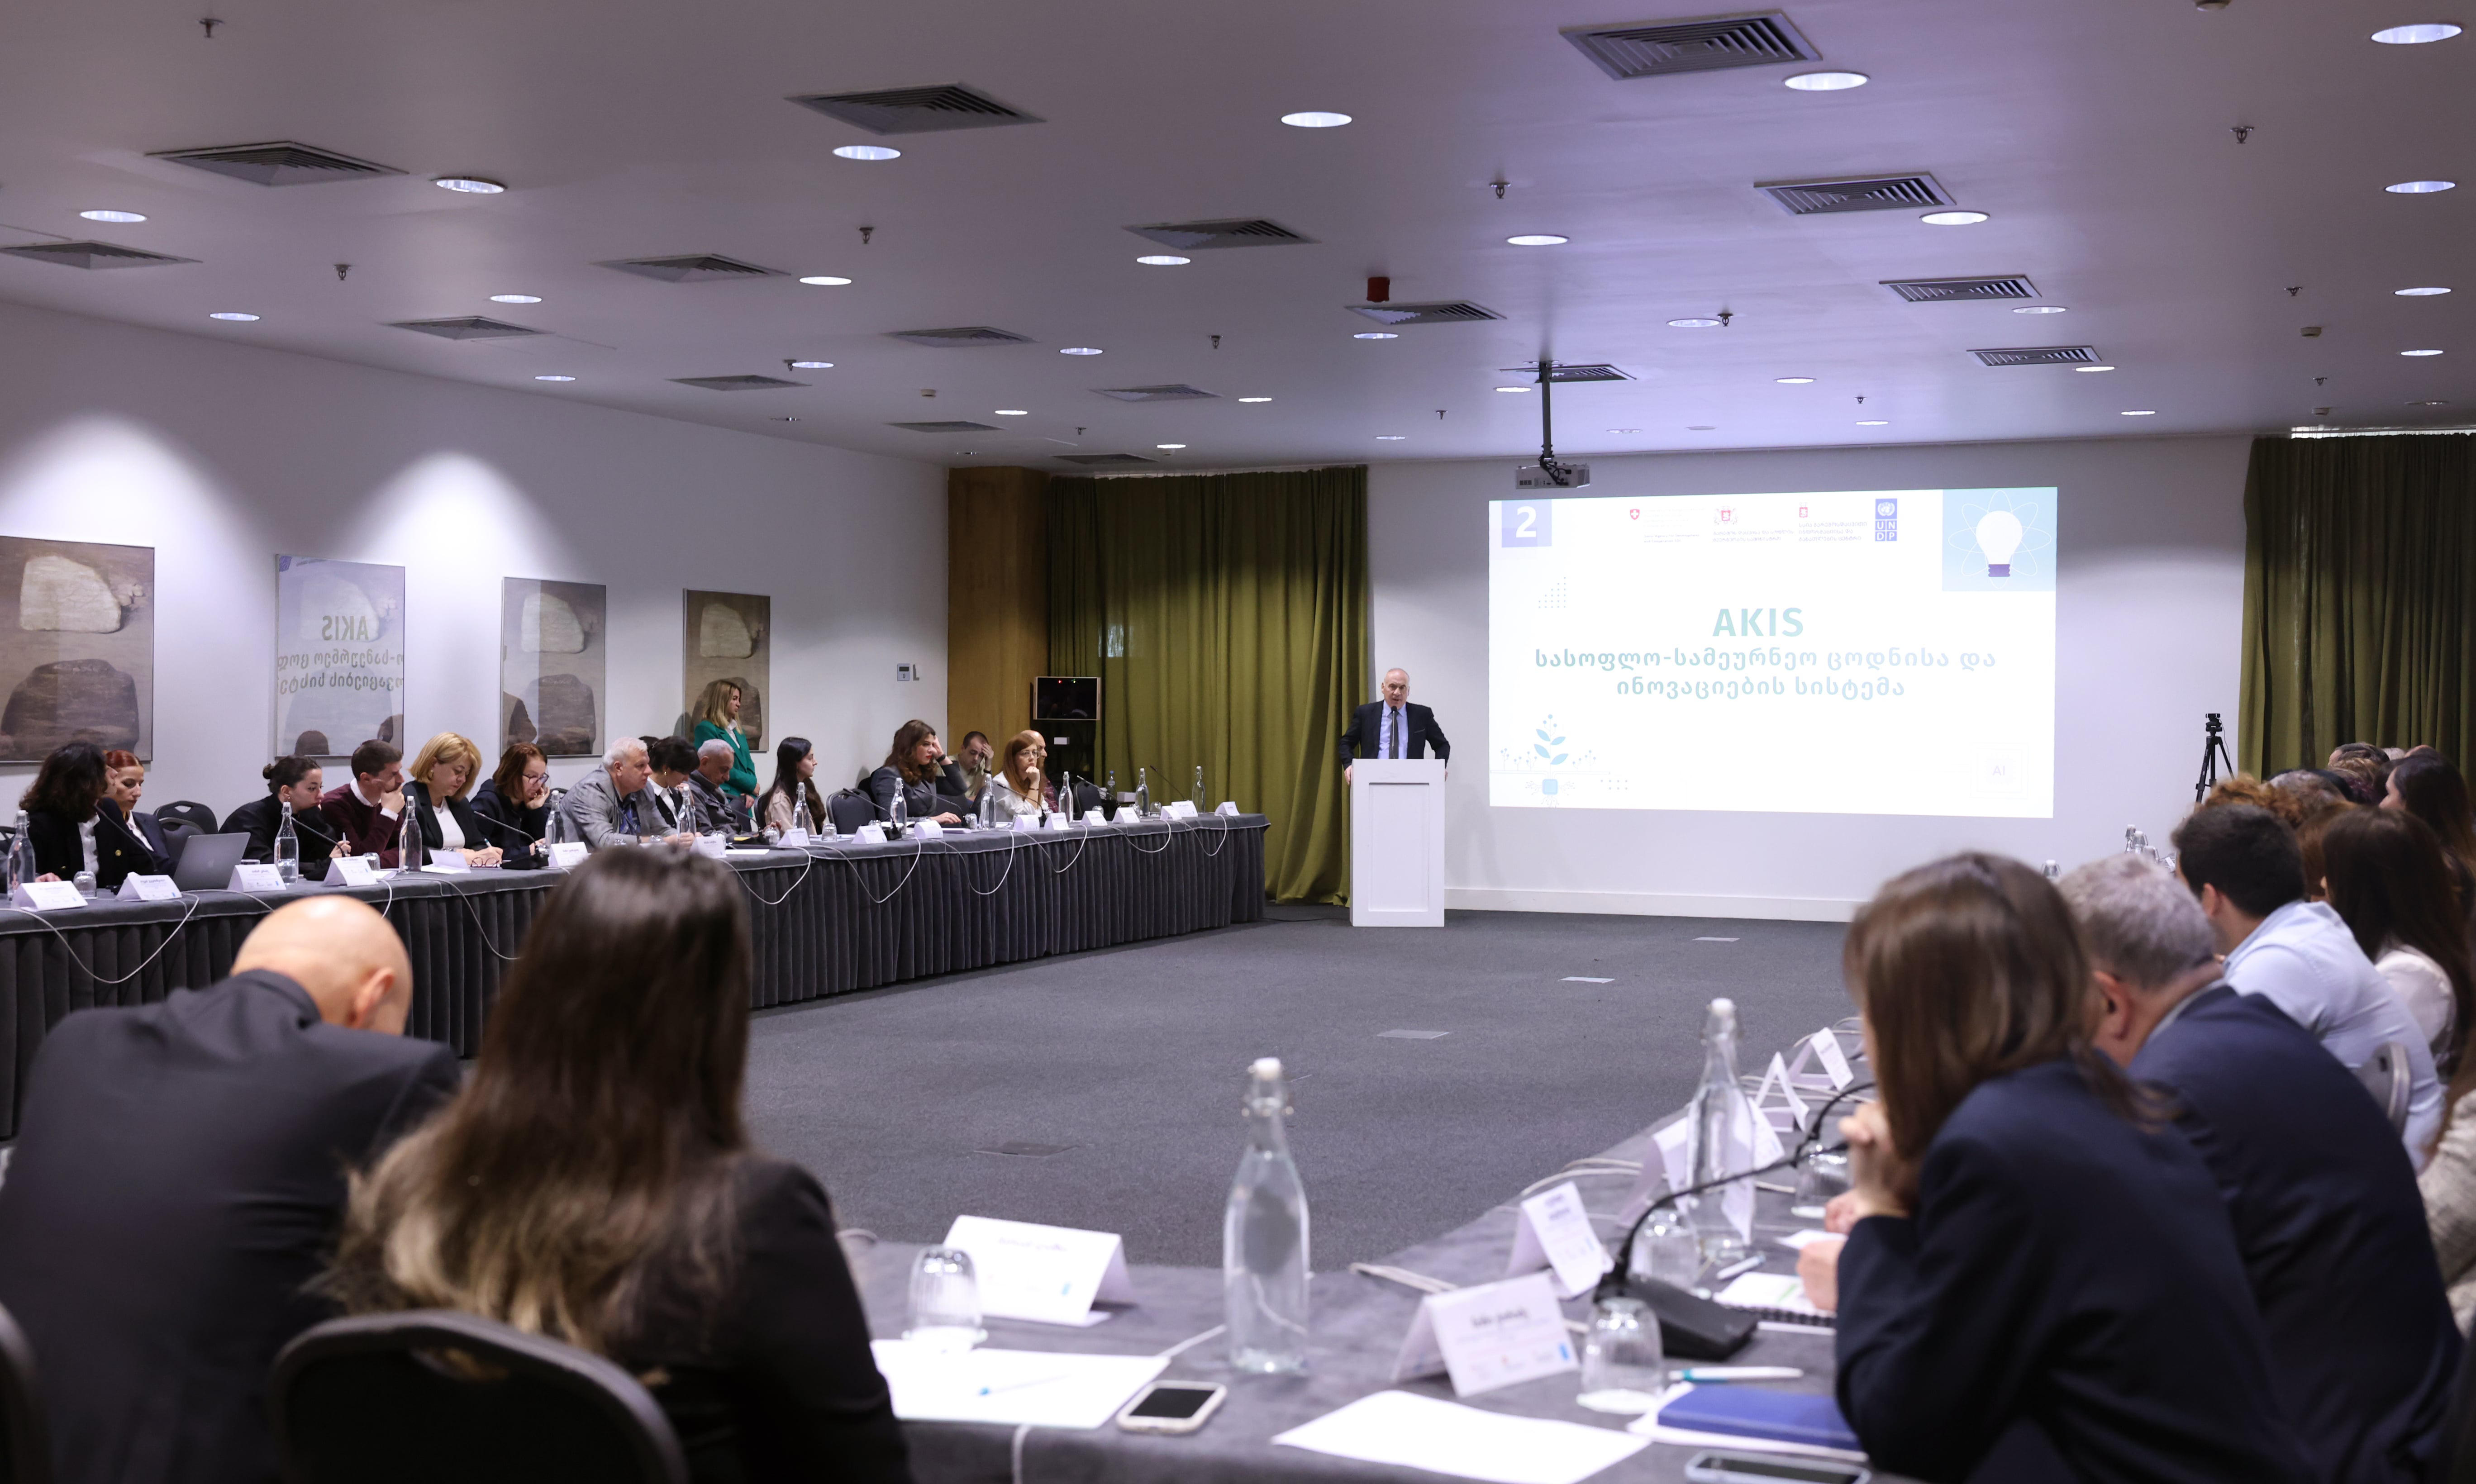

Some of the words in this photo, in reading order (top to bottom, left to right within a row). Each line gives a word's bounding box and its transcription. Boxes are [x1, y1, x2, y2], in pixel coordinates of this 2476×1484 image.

[1516, 506, 1536, 538] 2
[1877, 521, 1895, 529] UN
[1877, 532, 1895, 540] DP
[1713, 608, 1803, 637] AKIS
[1535, 647, 1817, 671] სასოფლო-სამეურნეო
[1828, 647, 1949, 671] ცოდნისა
[1960, 653, 1995, 671] და
[1617, 676, 1785, 700] ინოვაციების
[1795, 676, 1905, 701] სისტემა
[1992, 766, 2005, 775] AI
